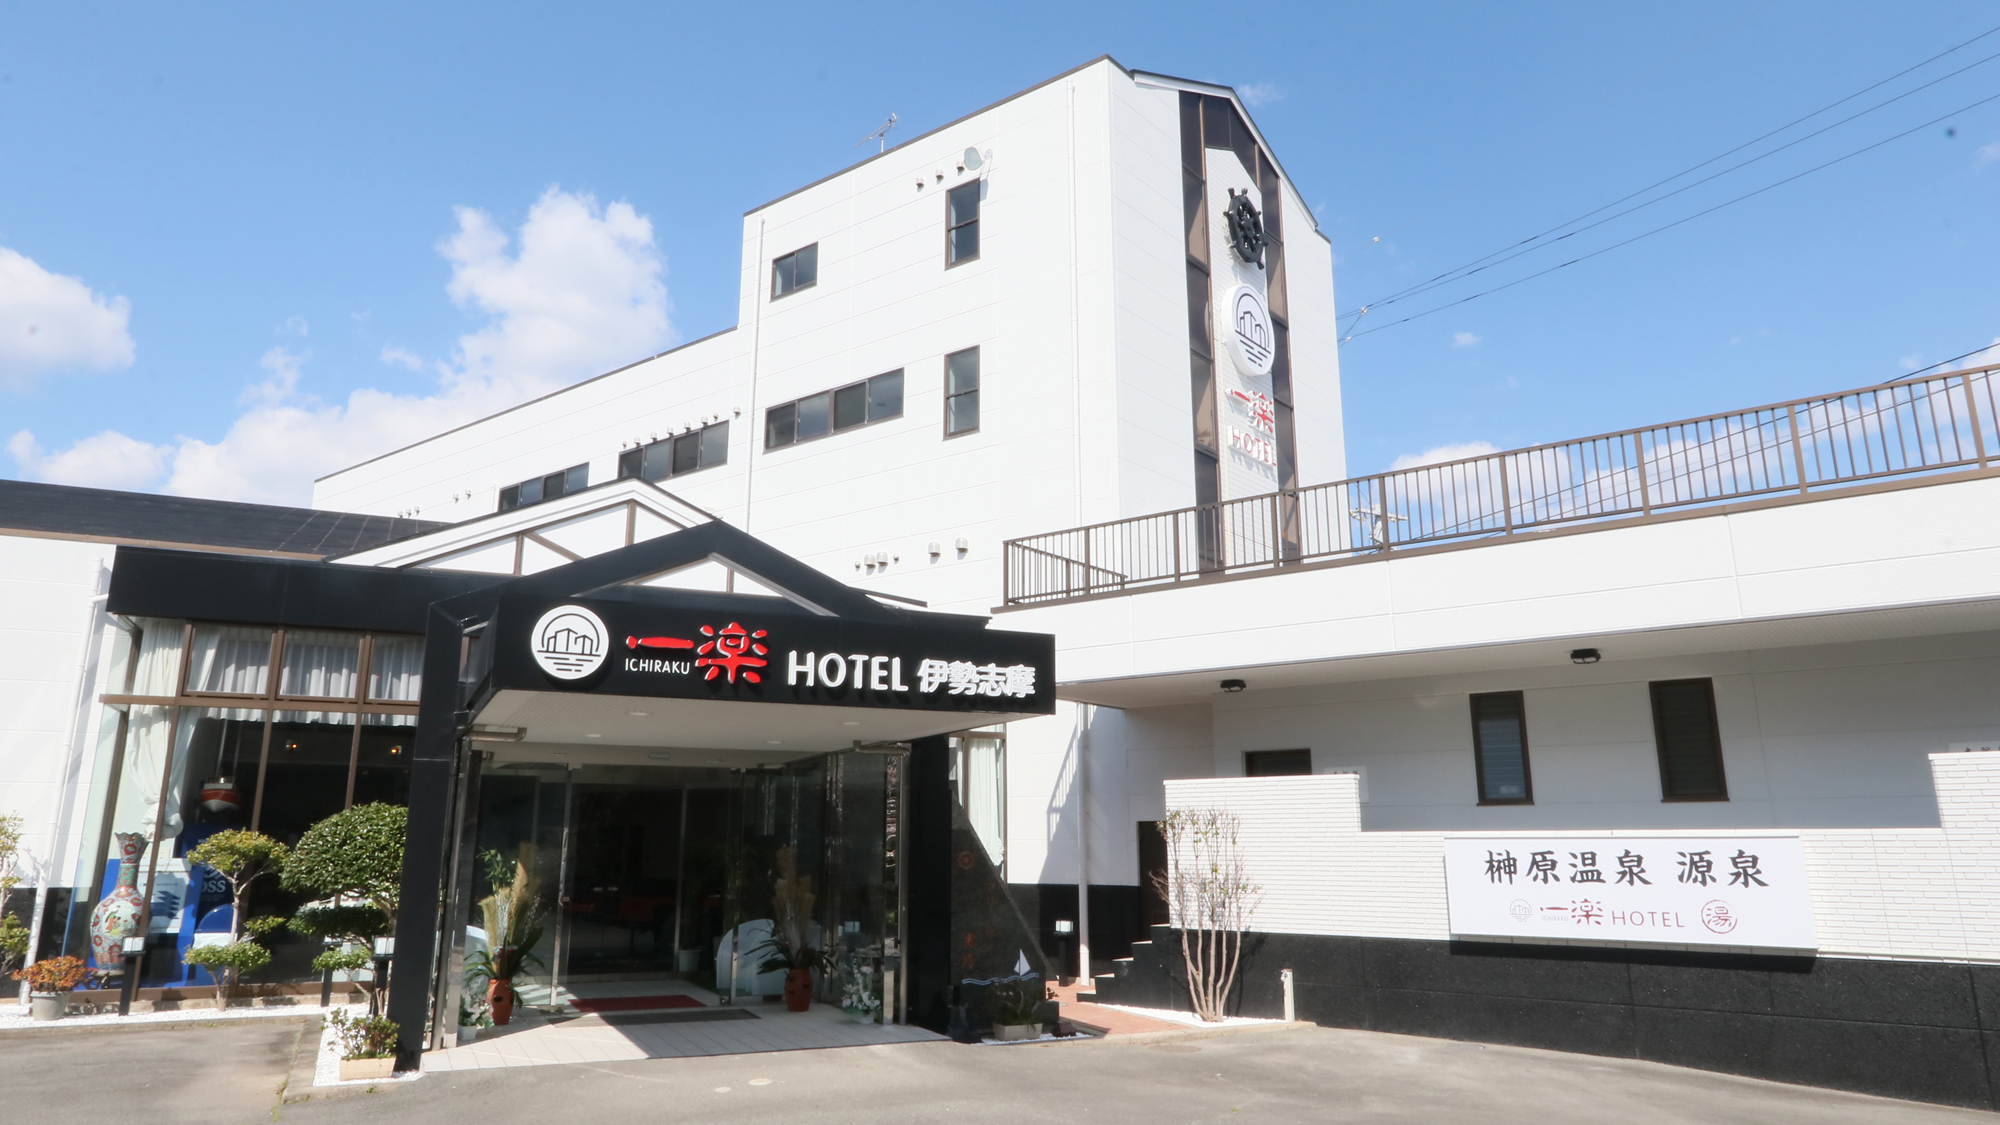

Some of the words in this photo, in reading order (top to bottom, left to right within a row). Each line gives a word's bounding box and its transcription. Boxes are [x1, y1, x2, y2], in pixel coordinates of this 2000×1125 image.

[1225, 388, 1274, 434] 一楽
[1227, 425, 1277, 466] HOTEL
[625, 622, 768, 684] 一楽
[787, 650, 909, 692] HOTEL
[917, 658, 1036, 698] 伊勢志摩
[625, 658, 690, 675] ICHIRAKU
[1484, 849, 1653, 887] 榊原温泉
[1675, 849, 1770, 888] 源泉
[1540, 898, 1604, 926] 一楽
[1611, 910, 1685, 928] HOTEL
[1705, 905, 1734, 928] 湯
[1541, 914, 1569, 922] ICHIRAKU
